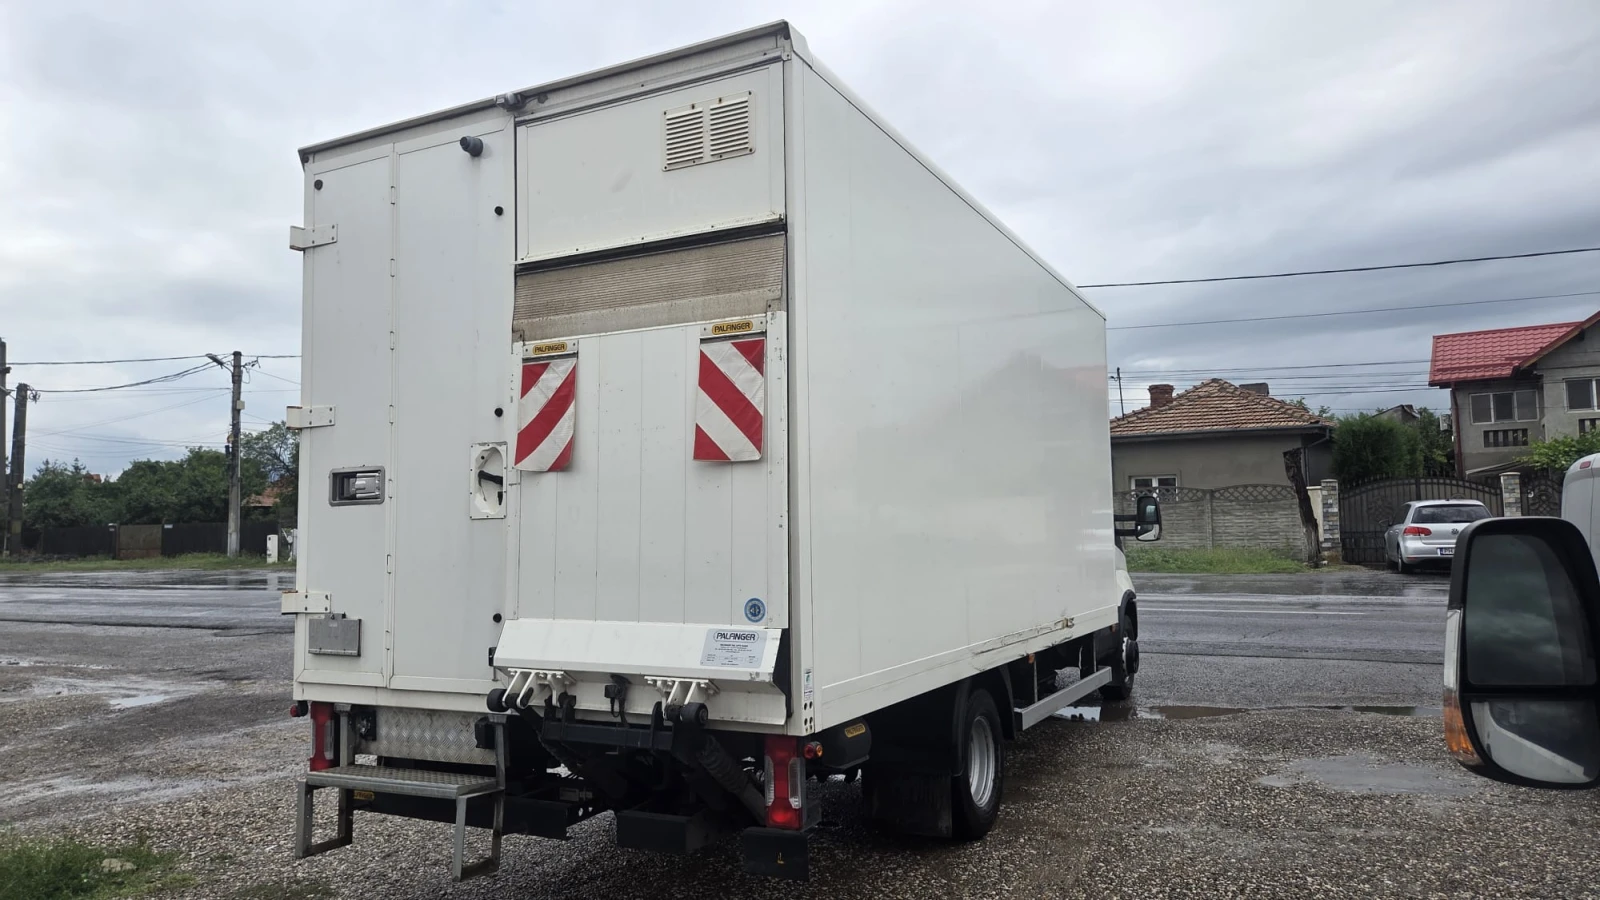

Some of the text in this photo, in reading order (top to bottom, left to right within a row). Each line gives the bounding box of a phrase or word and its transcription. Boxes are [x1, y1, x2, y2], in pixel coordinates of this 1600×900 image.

[714, 322, 751, 333] PALFINGER
[534, 343, 565, 353] PALFINGER
[716, 632, 756, 641] PALFINGER
